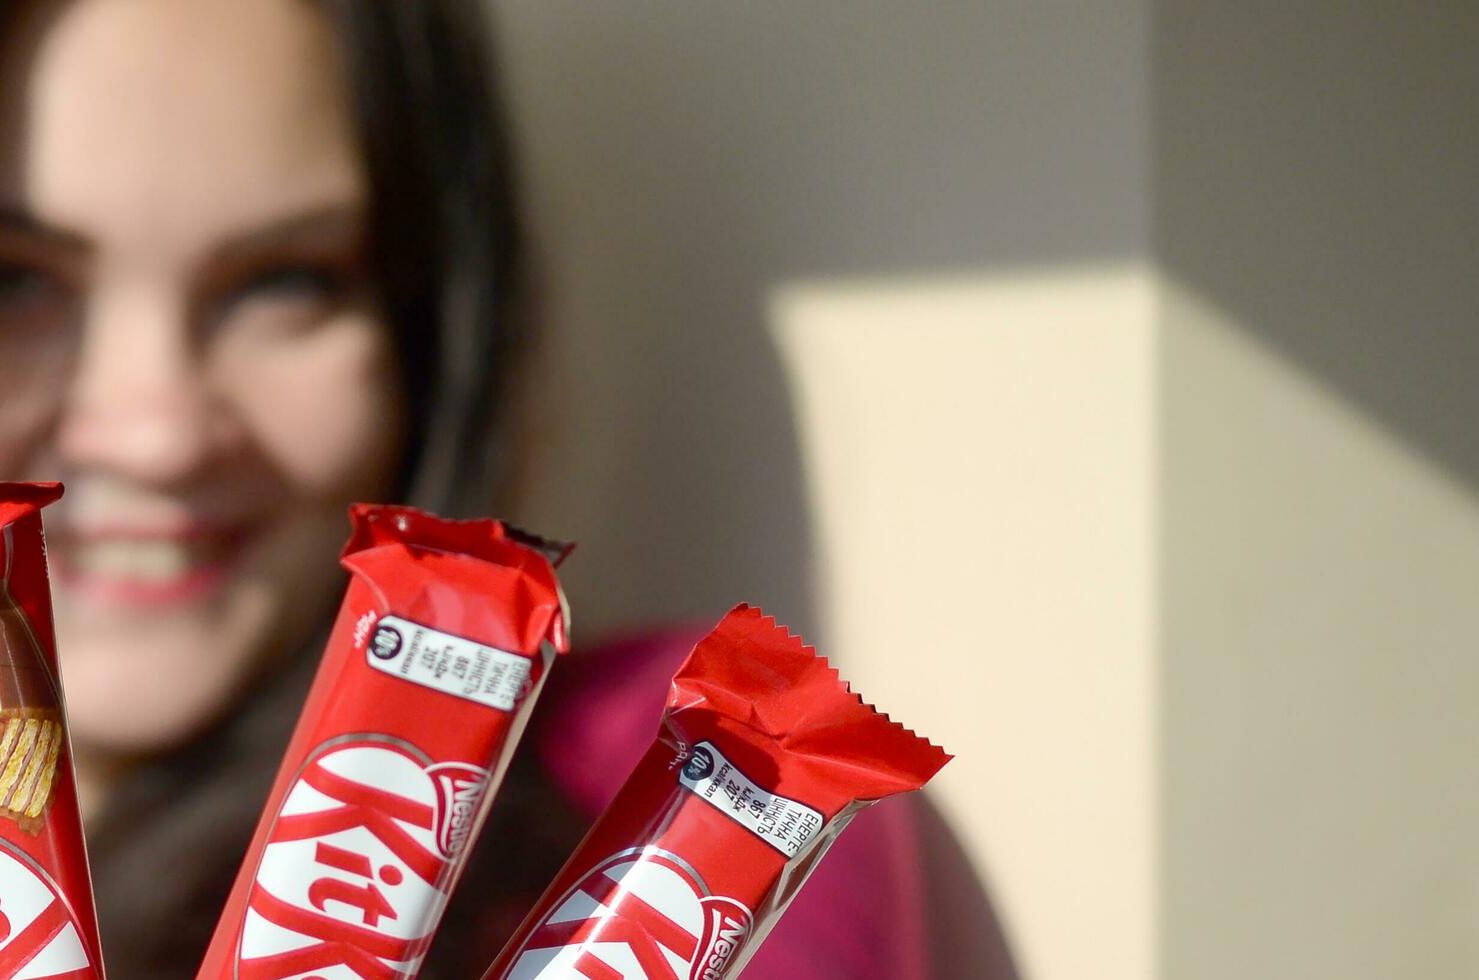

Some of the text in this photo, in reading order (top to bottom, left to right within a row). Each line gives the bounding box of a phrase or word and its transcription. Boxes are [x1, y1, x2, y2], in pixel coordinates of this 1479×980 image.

[687, 751, 710, 776] 10%
[724, 780, 740, 799] 207
[748, 800, 766, 819] 867
[757, 798, 788, 834] ЦІННІСТЬ
[774, 809, 802, 840] ТИЧНА
[787, 813, 819, 852] ЕНЕРГЕ-
